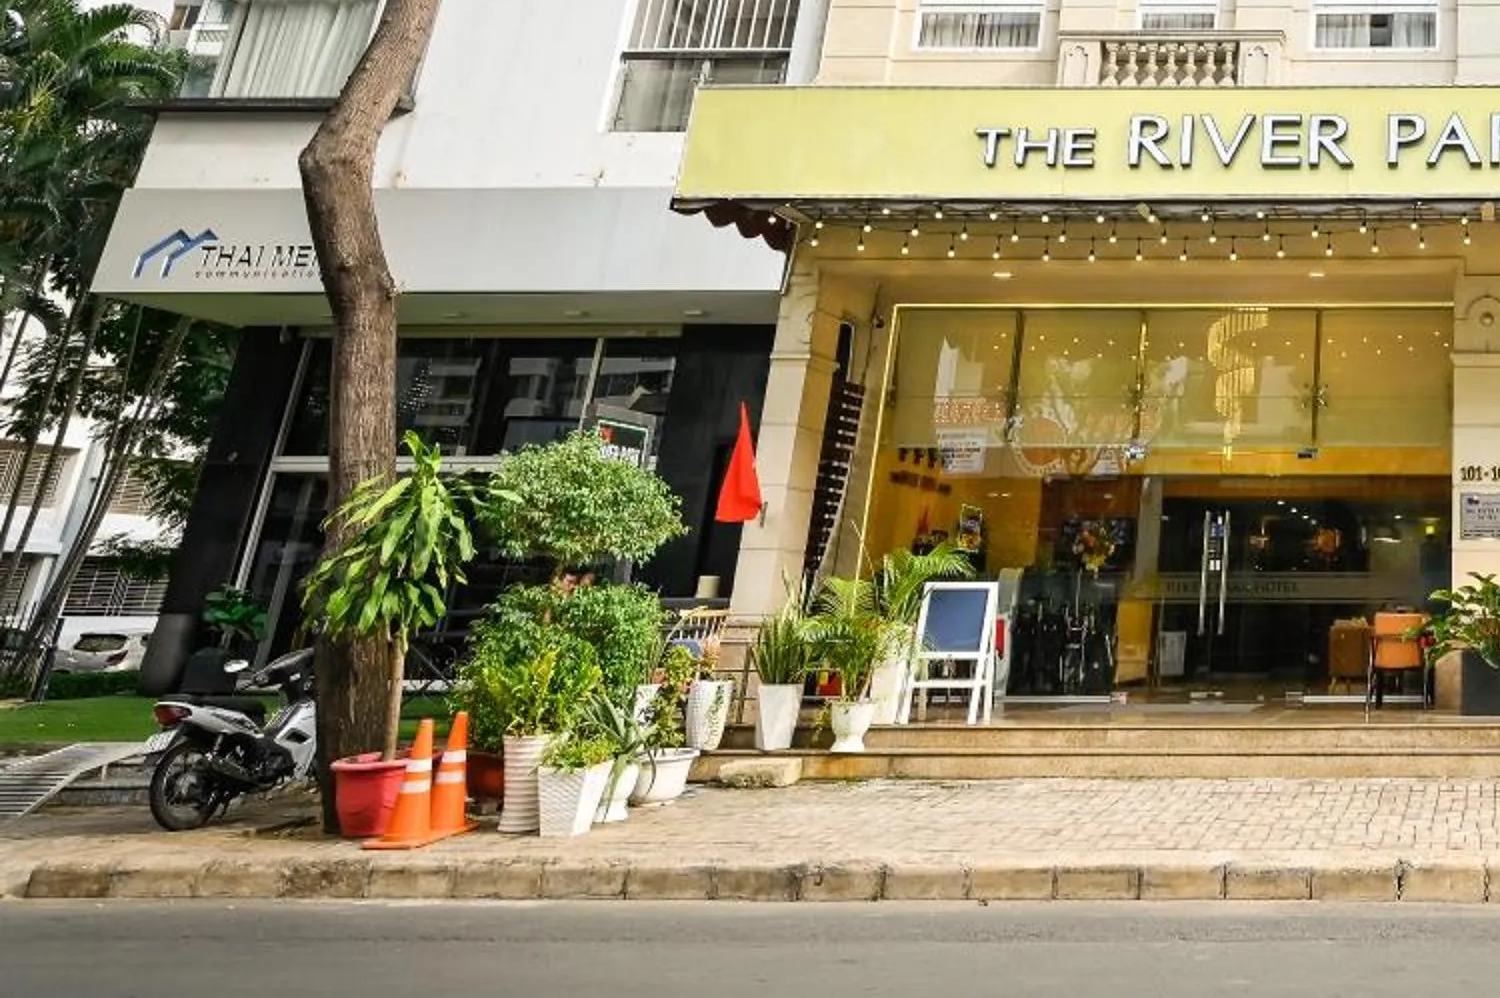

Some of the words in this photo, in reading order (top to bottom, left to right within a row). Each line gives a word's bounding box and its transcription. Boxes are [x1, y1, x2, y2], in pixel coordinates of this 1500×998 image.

[975, 127, 1096, 167] THE
[1127, 113, 1354, 169] RIVER
[201, 245, 265, 267] THAI
[271, 245, 318, 267] ME
[194, 267, 321, 280] communicatio
